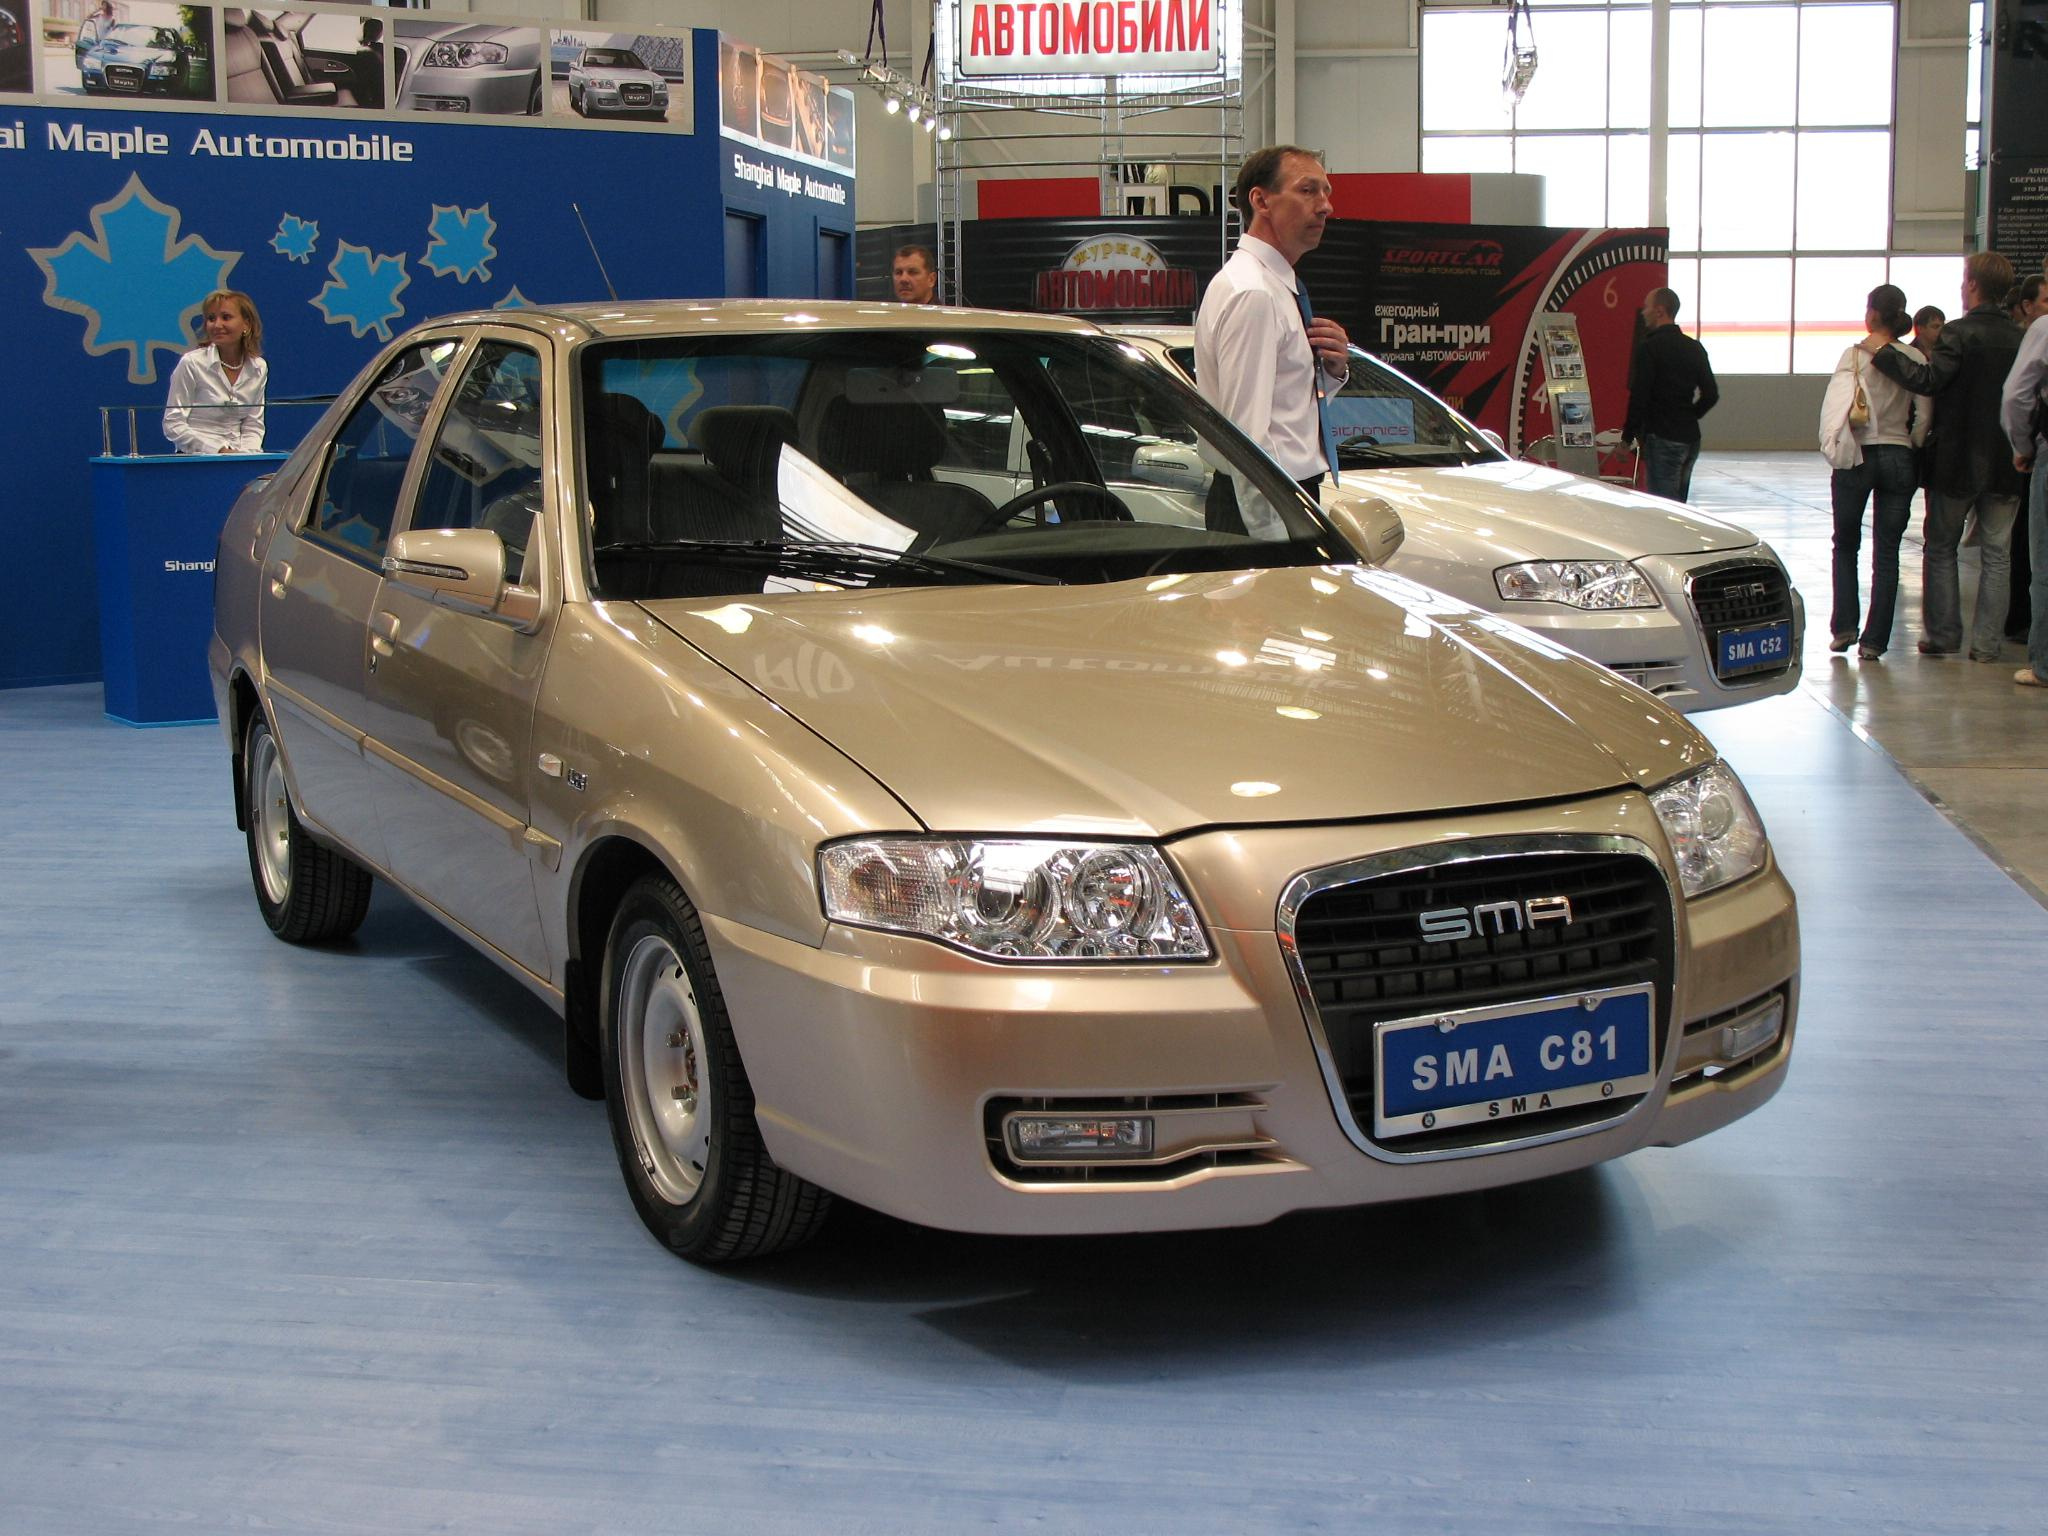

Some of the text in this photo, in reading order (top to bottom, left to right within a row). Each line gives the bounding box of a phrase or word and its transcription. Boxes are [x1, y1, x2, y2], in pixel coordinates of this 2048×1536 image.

[970, 0, 1210, 57] АВТОМОБИЛИ
[47, 122, 169, 160] Maple
[190, 128, 414, 162] Automobile
[734, 153, 846, 206] Shanghai Maple Automobile
[1038, 269, 1195, 308] АВТОМОБИЛИ
[1374, 302, 1440, 320] ежегодный
[1380, 317, 1491, 349] Гран-при
[164, 558, 217, 573] Shang
[1722, 582, 1767, 600] SMA
[1728, 636, 1783, 662] SMA C52
[1418, 895, 1576, 944] SMA
[1411, 1024, 1619, 1092] SMA C81
